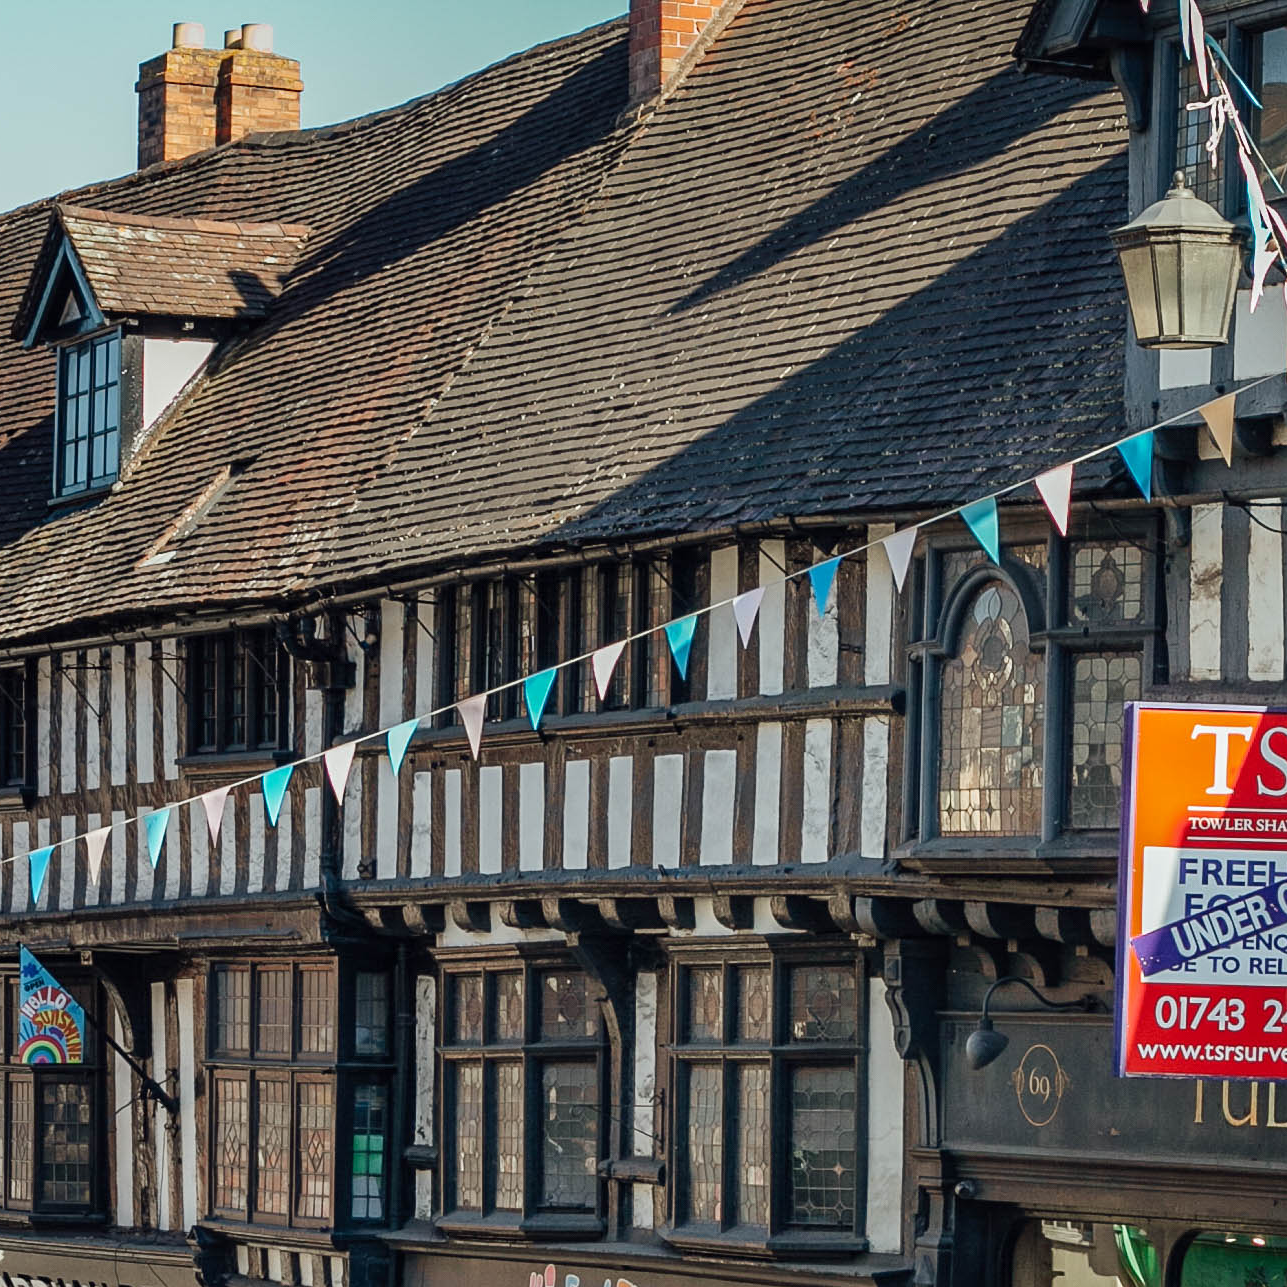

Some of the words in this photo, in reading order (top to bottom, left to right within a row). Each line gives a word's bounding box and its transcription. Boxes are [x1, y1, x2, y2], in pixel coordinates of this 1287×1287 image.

[1187, 817, 1254, 833] TOWLER
[1170, 894, 1274, 959] UNDER
[1207, 956, 1241, 974] TO
[1155, 996, 1246, 1032] 01743
[1029, 1067, 1051, 1104] 69
